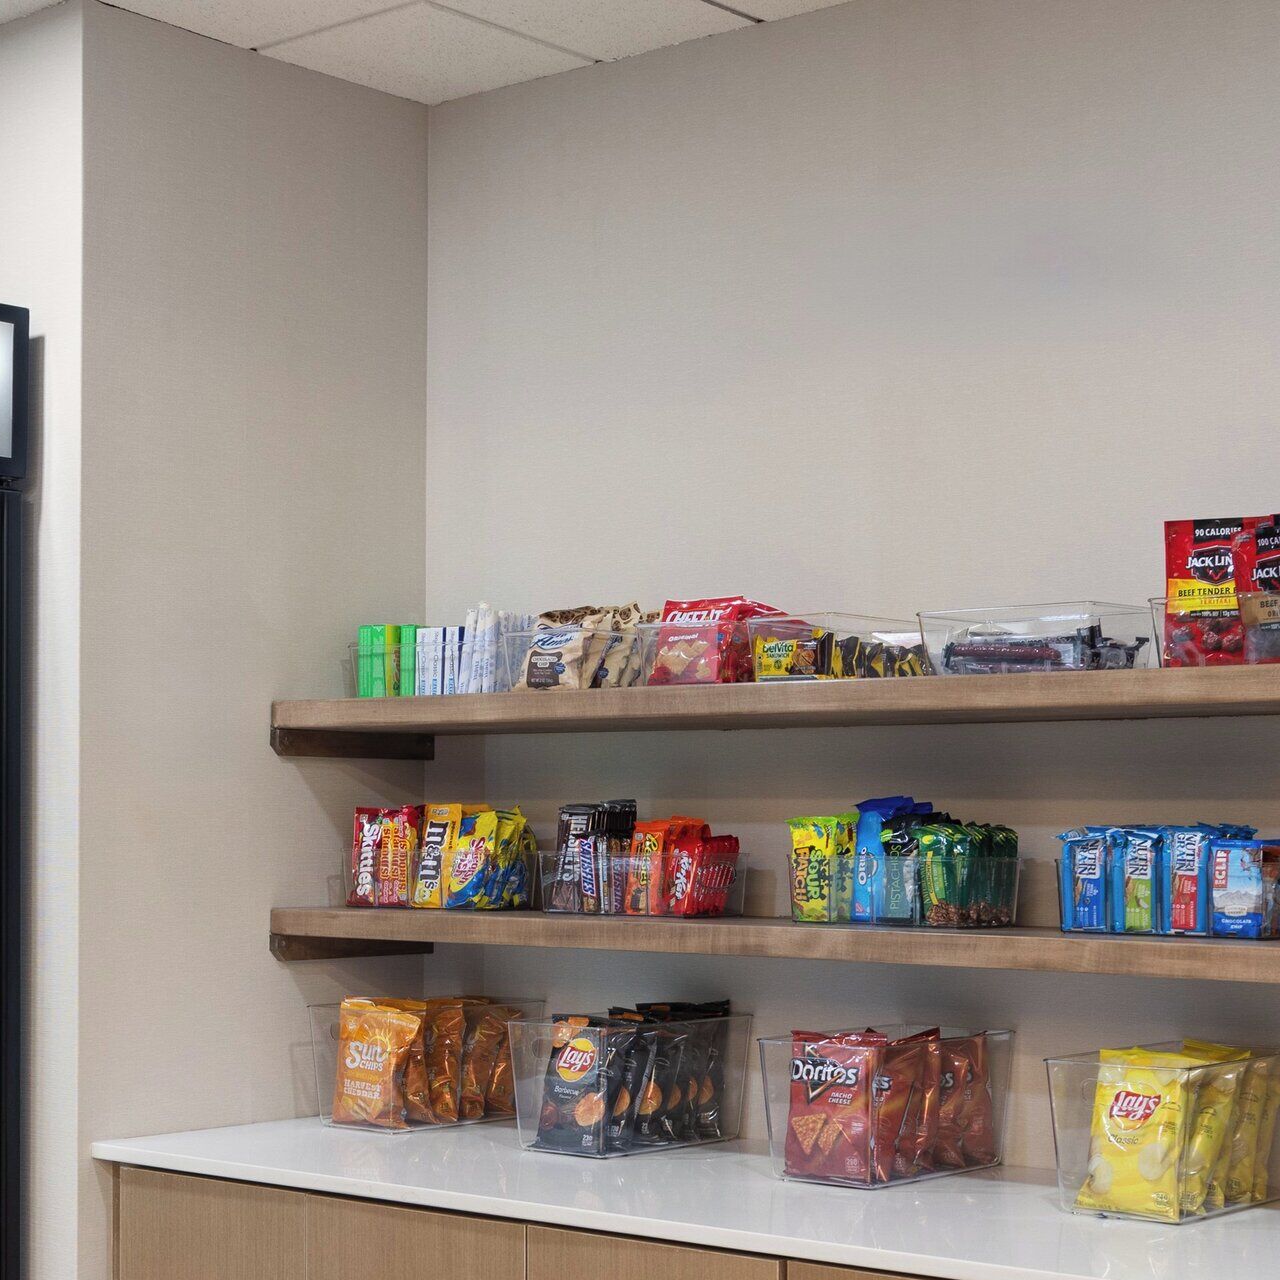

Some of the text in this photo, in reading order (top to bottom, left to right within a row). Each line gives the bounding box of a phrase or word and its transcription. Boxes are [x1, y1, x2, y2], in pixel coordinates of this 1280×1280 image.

[1194, 528, 1205, 537] 90
[1257, 537, 1269, 547] 100
[1186, 555, 1214, 570] JACK
[1251, 567, 1278, 581] JACK
[1178, 586, 1231, 598] BEEF TENDER
[1260, 598, 1277, 609] BEEF
[762, 642, 794, 653] belVita
[356, 822, 380, 896] Skittles
[1137, 839, 1148, 877] NUTRI
[1176, 833, 1186, 872] GRAIN
[1185, 834, 1197, 873] NUTRI
[580, 839, 595, 895] SATISFIES
[793, 846, 810, 902] PATCH
[806, 849, 823, 900] SOUR
[889, 844, 902, 910] PISTACHIOS
[345, 1041, 388, 1069] Sun
[558, 1047, 594, 1072] Lay's
[359, 1061, 384, 1072] CHIPS
[791, 1059, 858, 1086] Doritos
[344, 1079, 382, 1091] HARVEST
[554, 1085, 580, 1096] Barbecue
[343, 1088, 381, 1099] CHEDDAR
[831, 1092, 853, 1100] NACHO
[828, 1097, 851, 1105] CHEESE
[1111, 1091, 1159, 1121] Lay's
[1108, 1134, 1139, 1146] Classic
